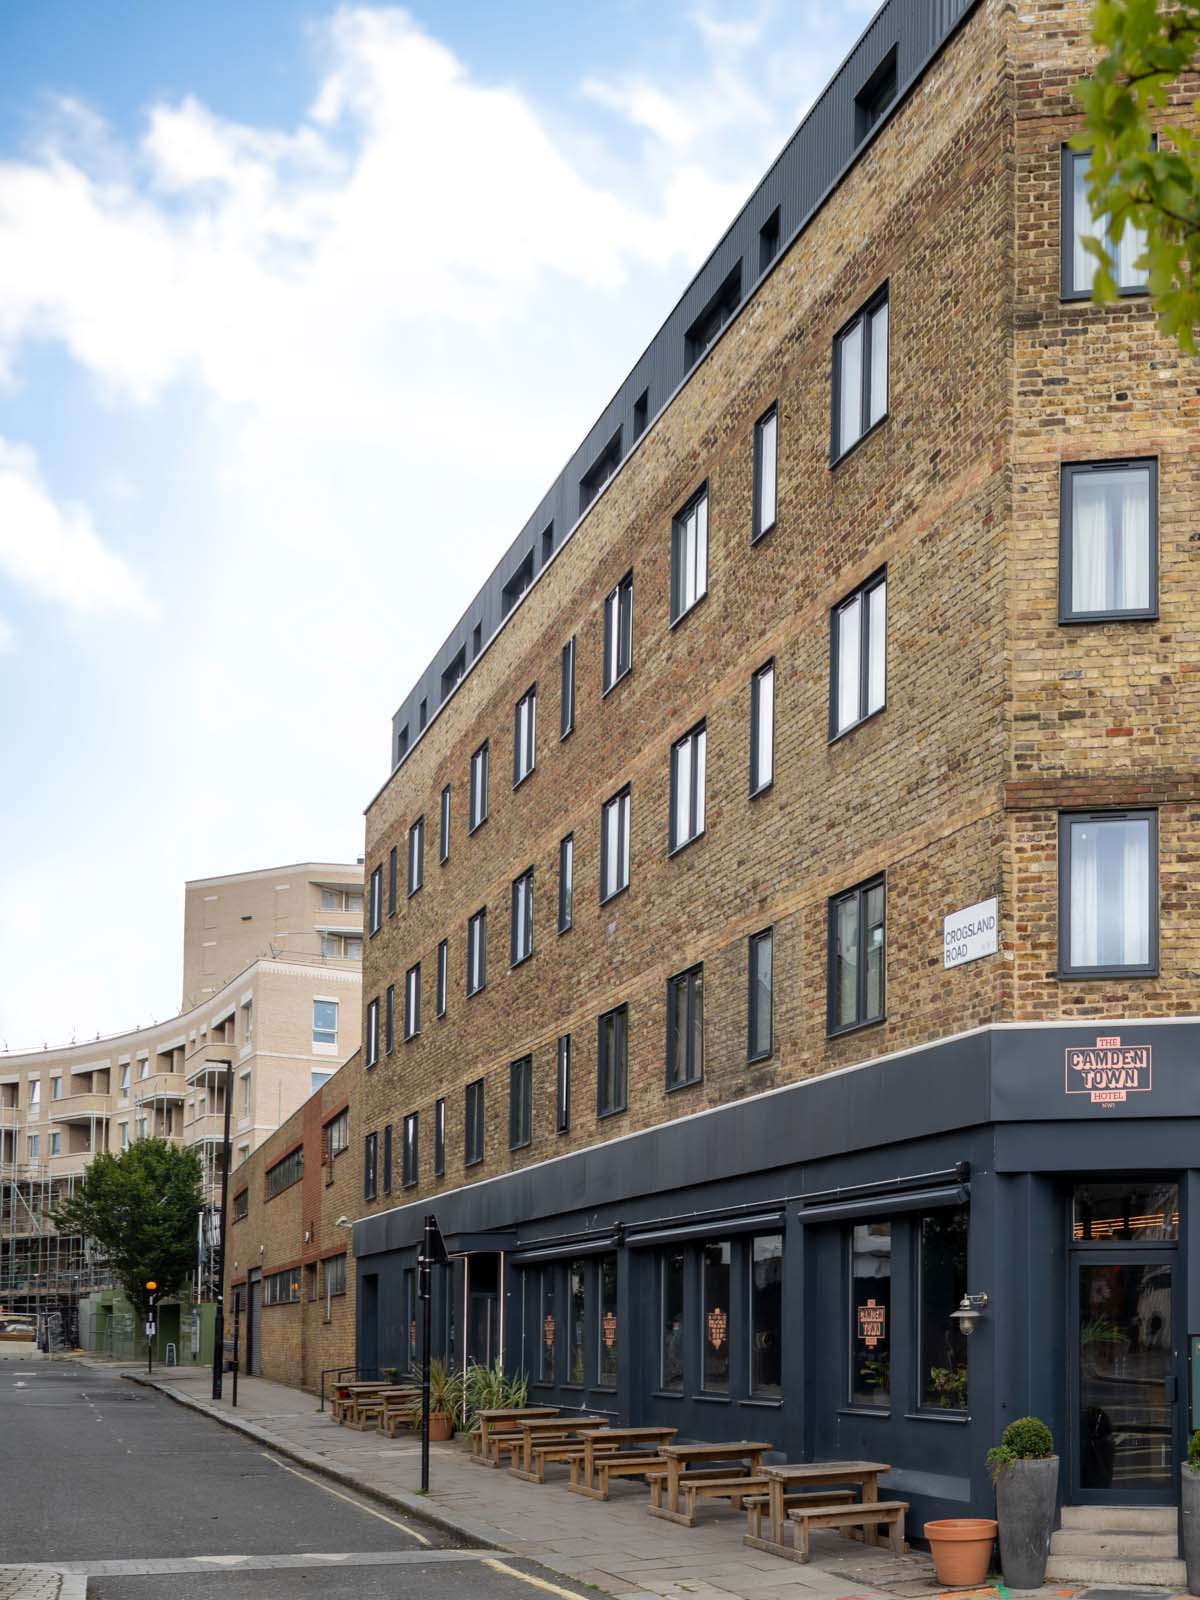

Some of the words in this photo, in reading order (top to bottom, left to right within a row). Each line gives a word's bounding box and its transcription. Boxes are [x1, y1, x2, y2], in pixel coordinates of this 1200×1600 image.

[945, 915, 995, 945] CROGSLAND
[945, 943, 968, 963] ROAD
[1099, 1038, 1118, 1047] THE
[1071, 1049, 1147, 1070] CAMDEN
[1081, 1068, 1138, 1089] TOWN
[1094, 1091, 1124, 1101] HOTEL
